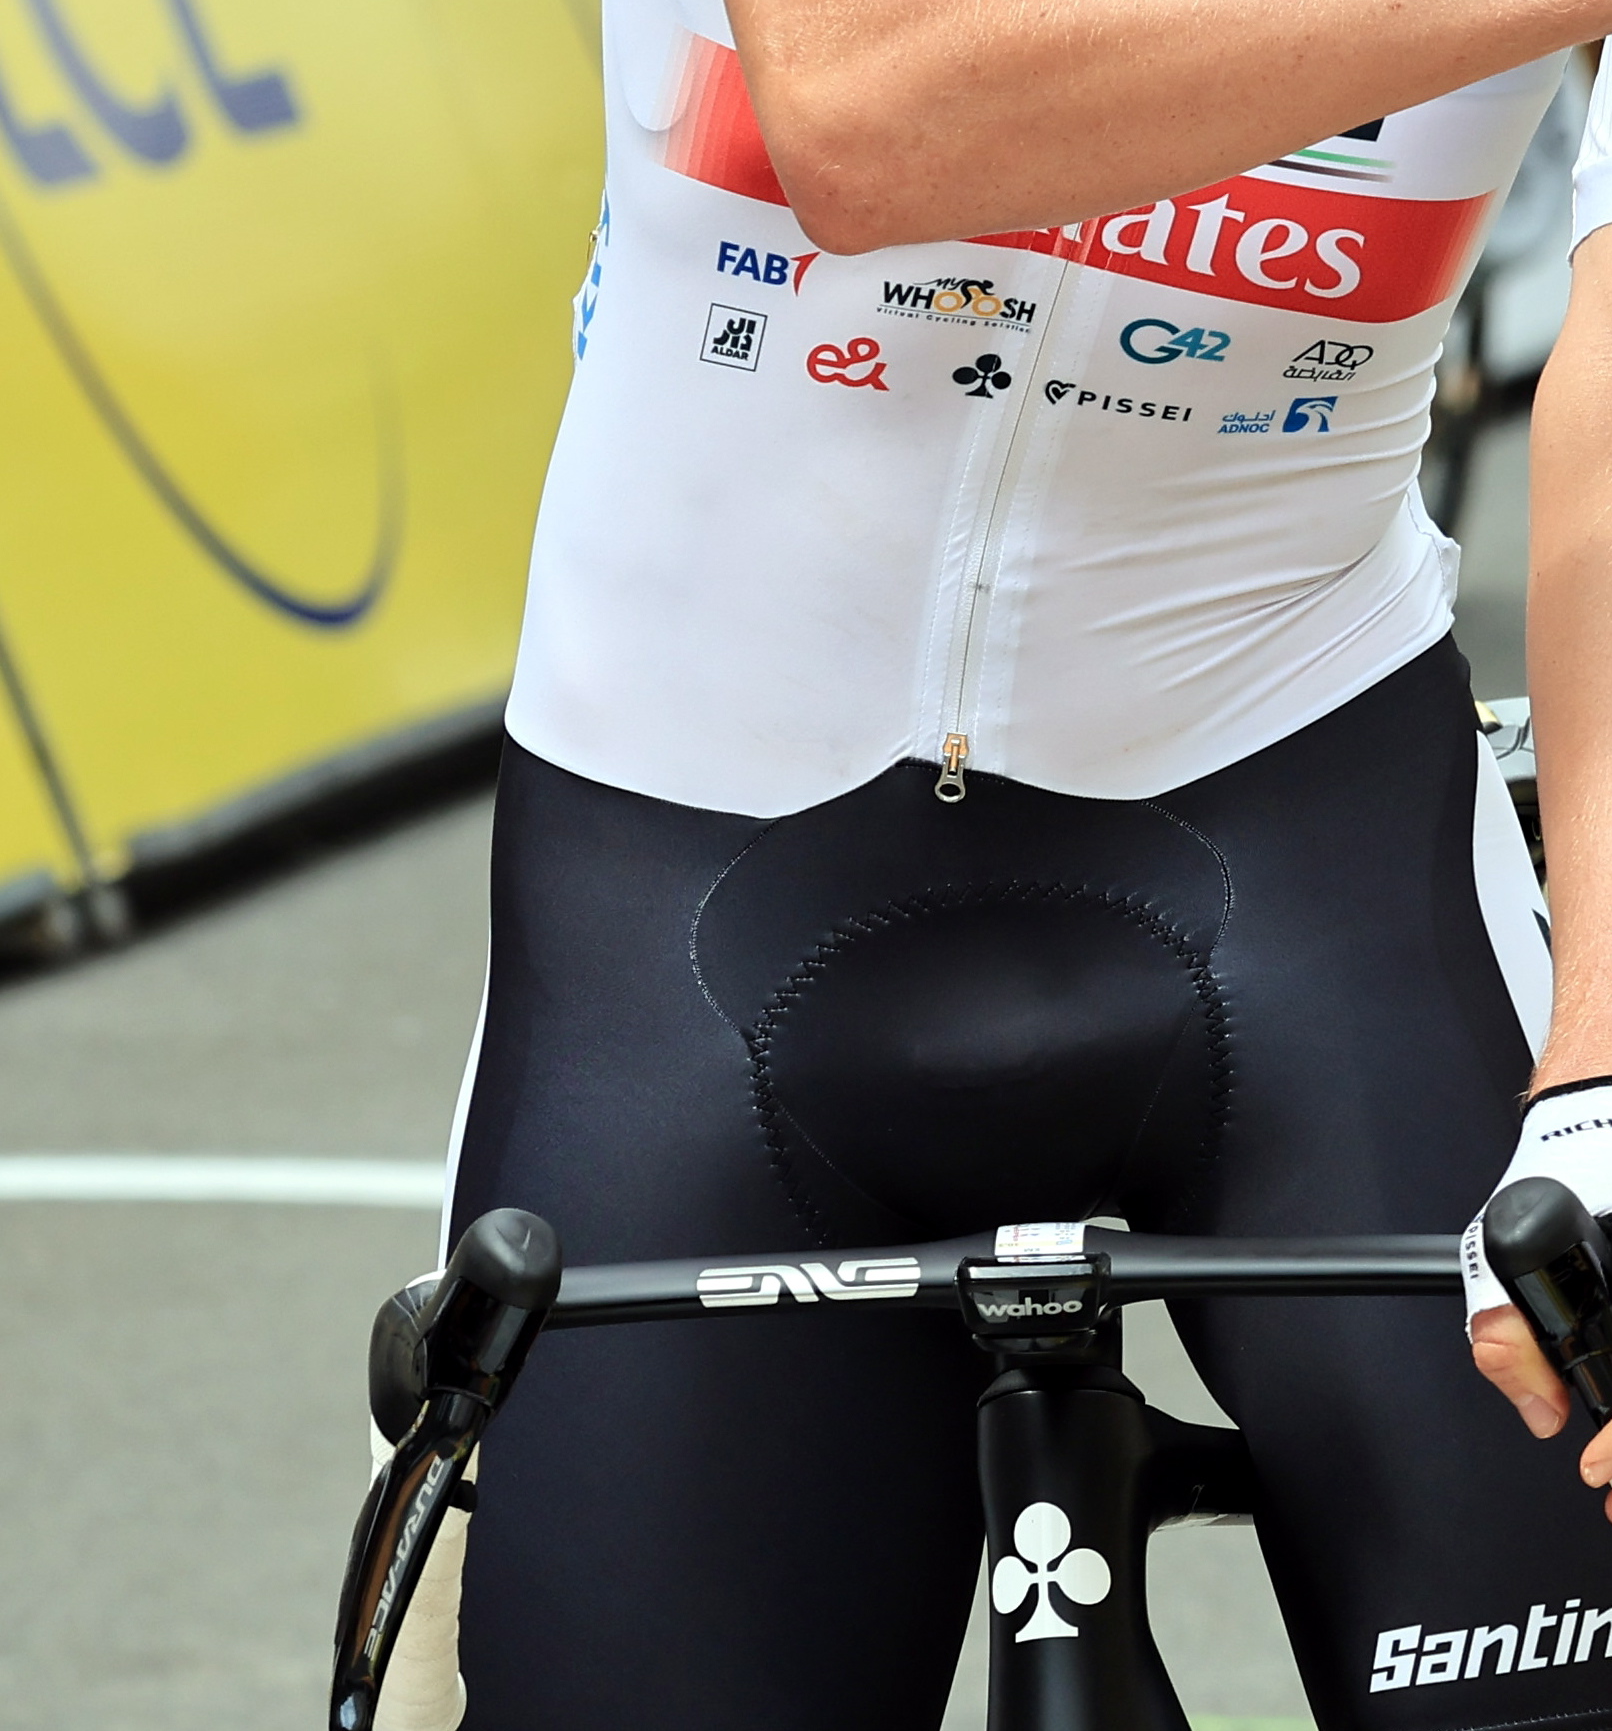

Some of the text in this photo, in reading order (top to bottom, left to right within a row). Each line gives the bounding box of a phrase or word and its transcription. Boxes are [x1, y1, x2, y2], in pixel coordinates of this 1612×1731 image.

[717, 241, 789, 286] FAB
[884, 281, 1037, 323] WHOOSH
[926, 314, 976, 326] Cycling
[711, 346, 749, 361] ALDAR
[1120, 318, 1231, 364] G42
[1291, 340, 1374, 370] ADQ
[1077, 390, 1192, 422] PISSEI
[1217, 423, 1271, 434] ADNOC
[977, 1297, 1083, 1317] wahoo
[363, 1454, 445, 1659] DURA-ACE
